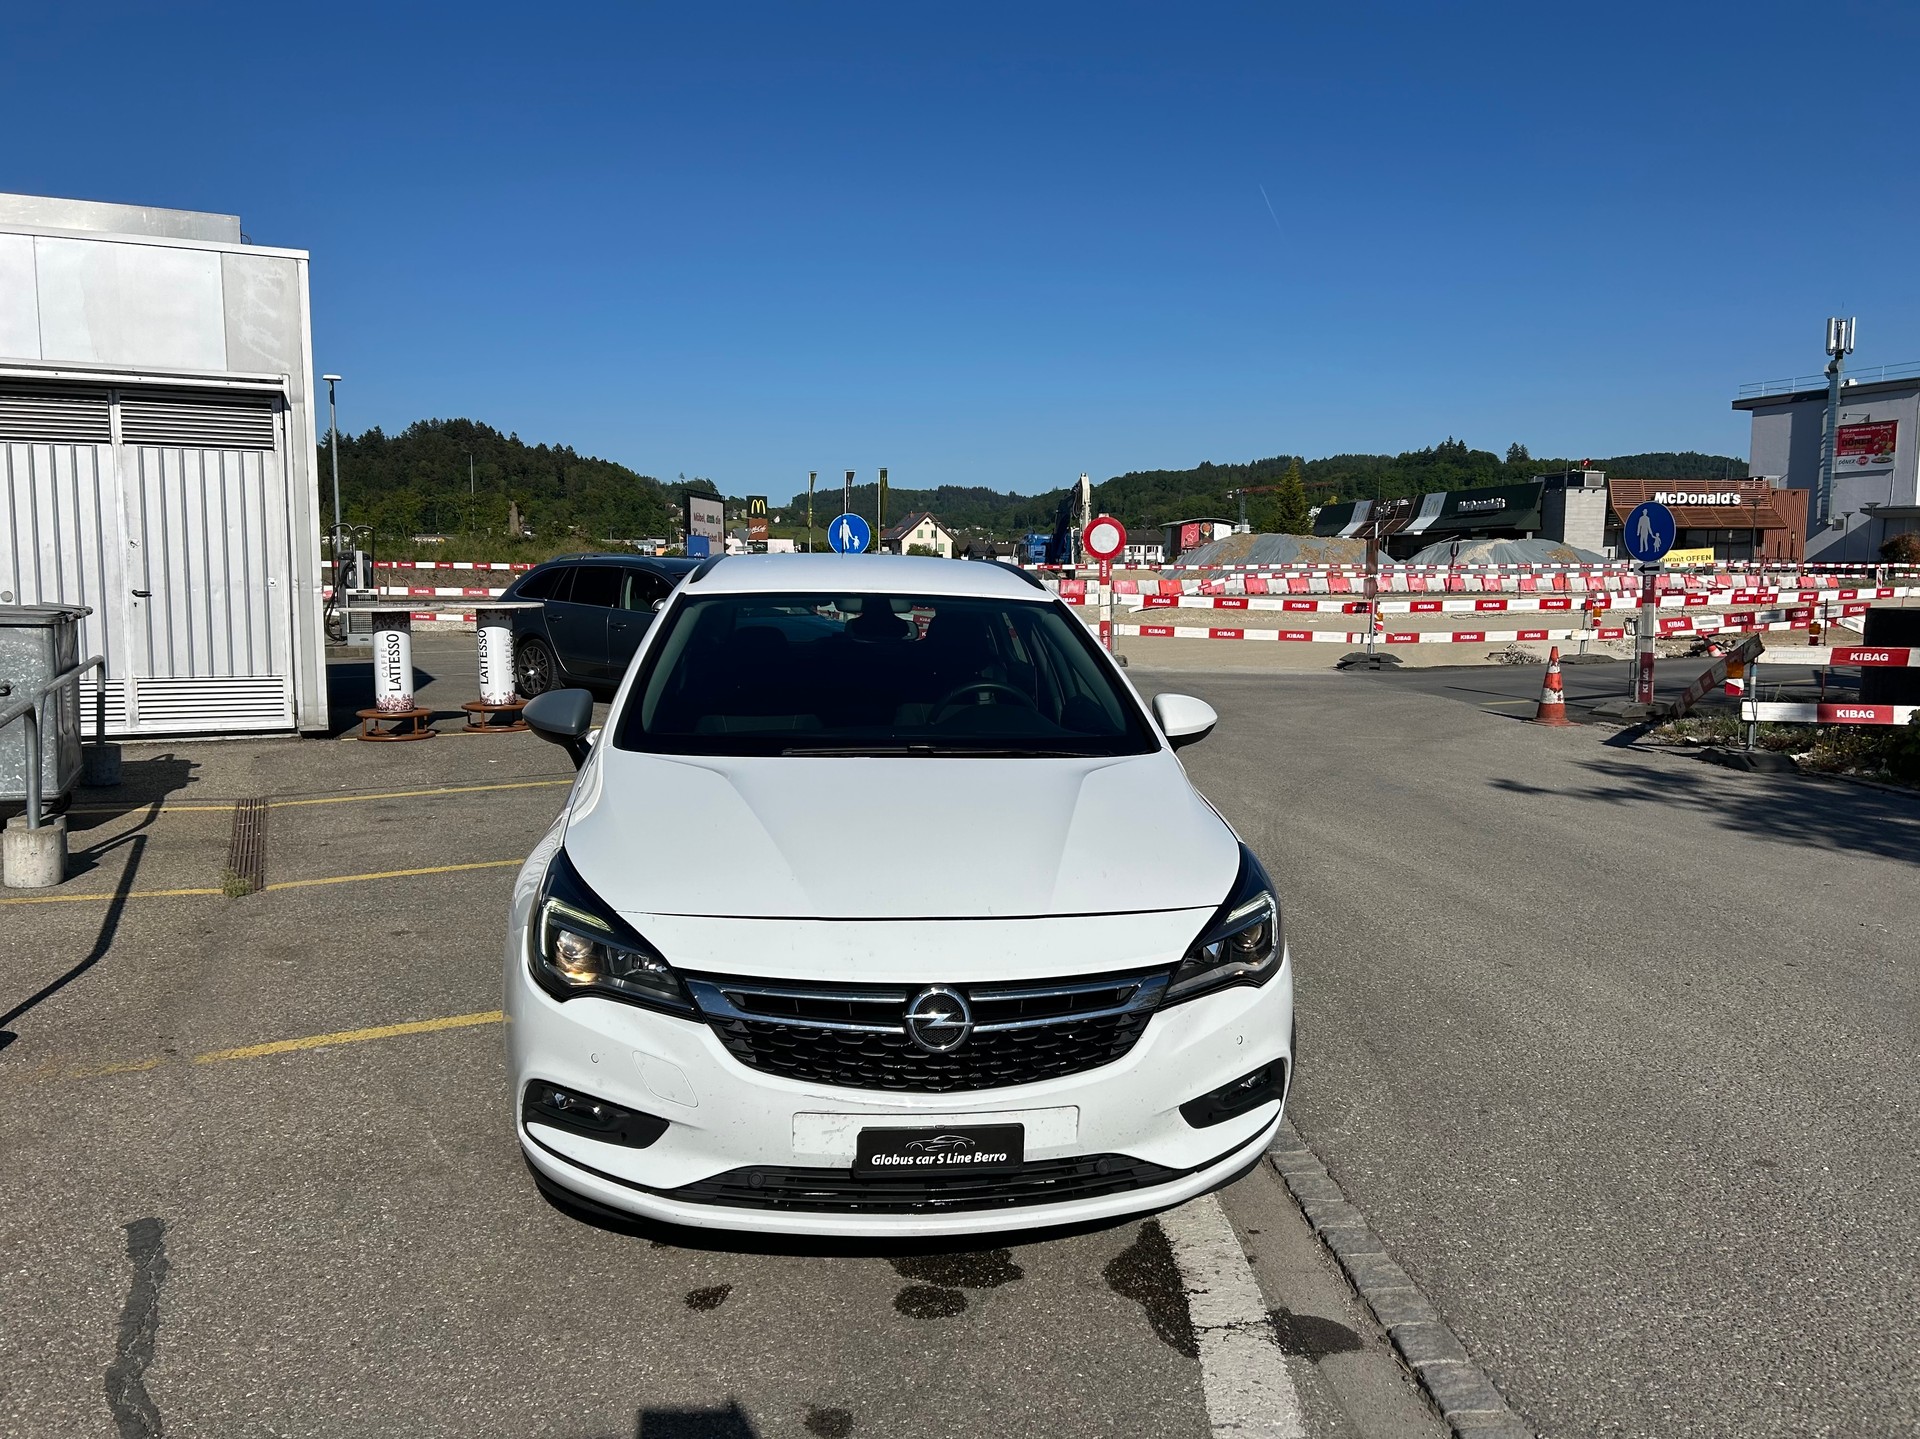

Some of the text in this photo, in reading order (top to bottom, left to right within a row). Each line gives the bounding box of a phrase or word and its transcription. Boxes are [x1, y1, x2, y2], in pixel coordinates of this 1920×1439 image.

[1654, 492, 1741, 504] McDonald's
[386, 634, 401, 691] LATTESSO
[478, 630, 488, 684] LATTESSO
[1850, 653, 1889, 661] KIBAG
[1836, 710, 1875, 718] KIBAG
[872, 1152, 1007, 1166] Globus car S Line Berro
